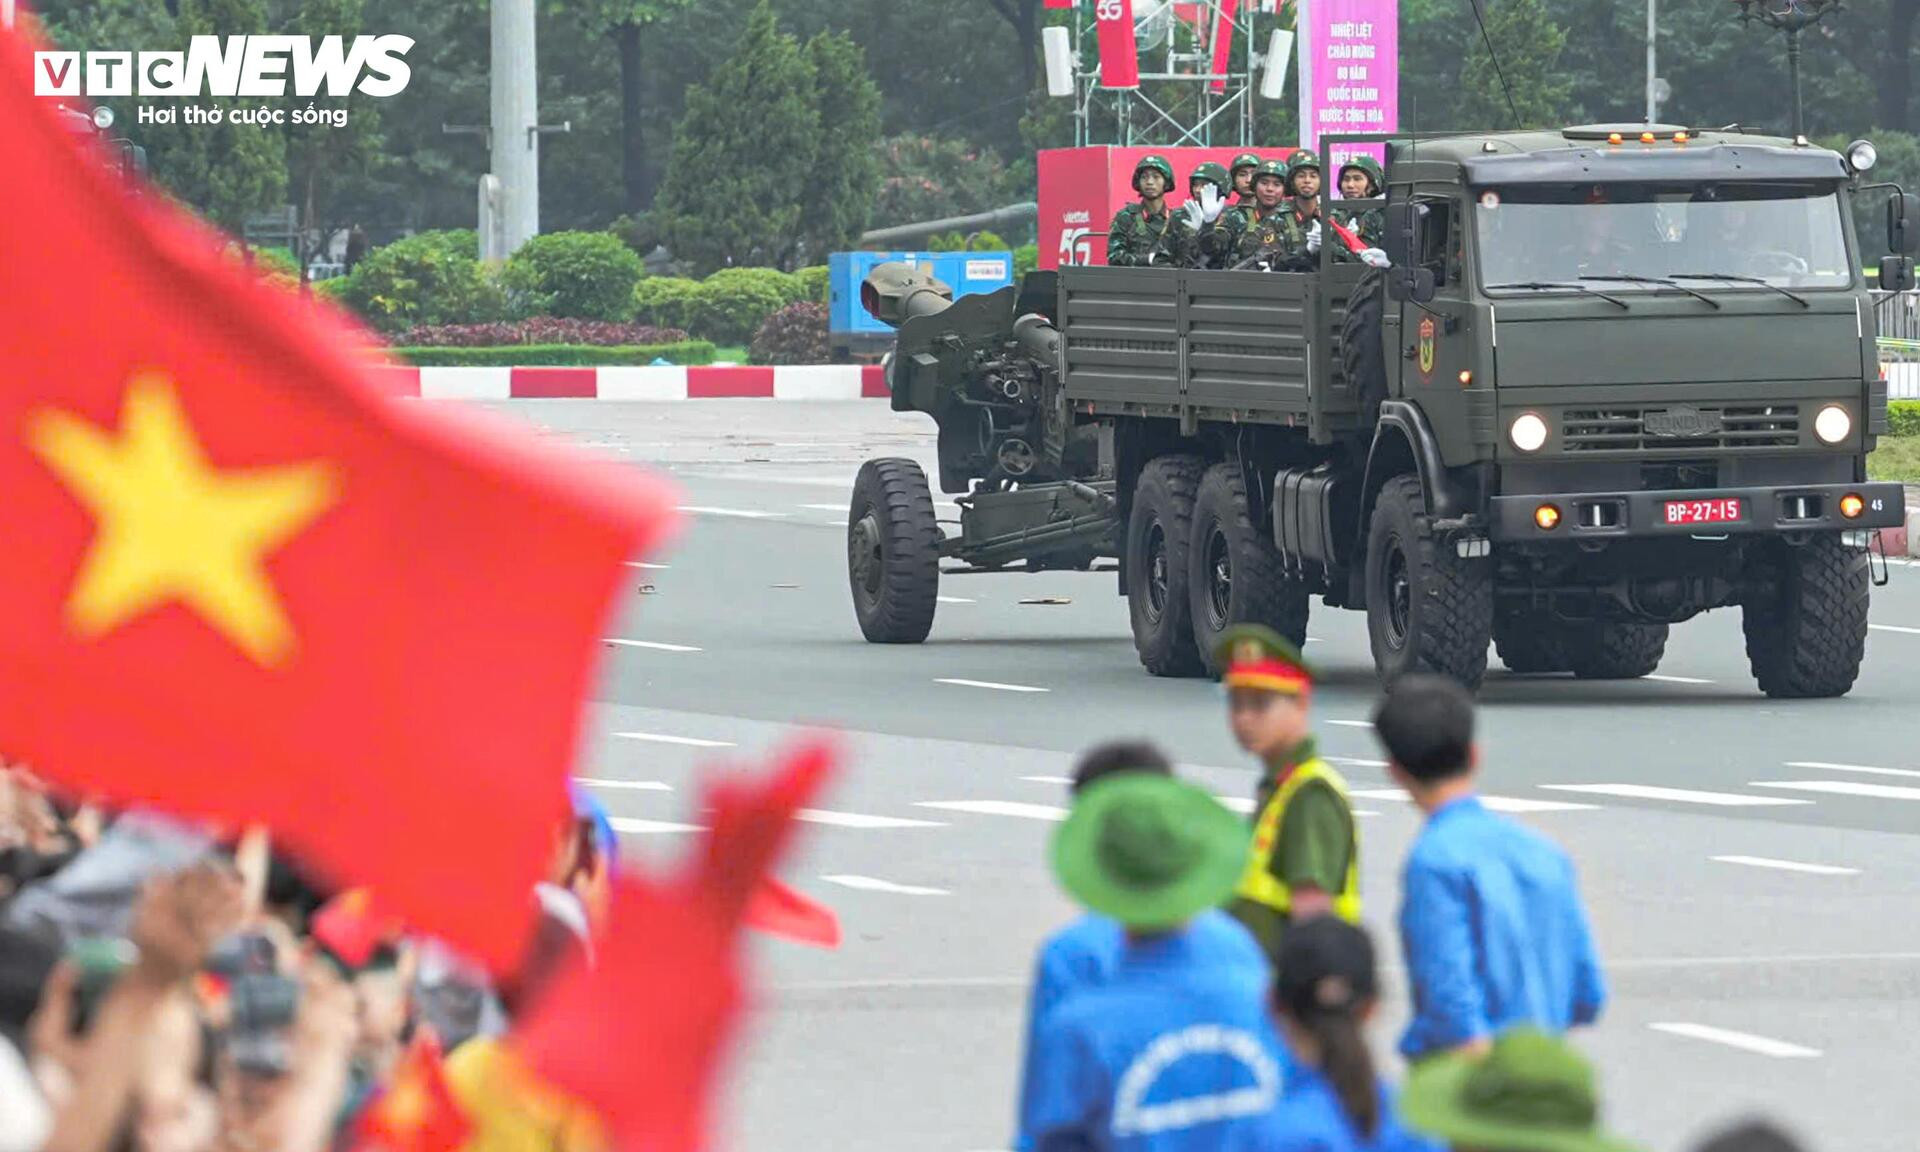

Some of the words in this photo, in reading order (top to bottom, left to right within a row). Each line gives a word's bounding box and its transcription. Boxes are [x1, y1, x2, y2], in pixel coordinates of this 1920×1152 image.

[1327, 83, 1351, 102] QUỐC
[1059, 228, 1090, 266] 5G
[1667, 500, 1737, 521] BP-27-15
[1871, 499, 1883, 511] 45
